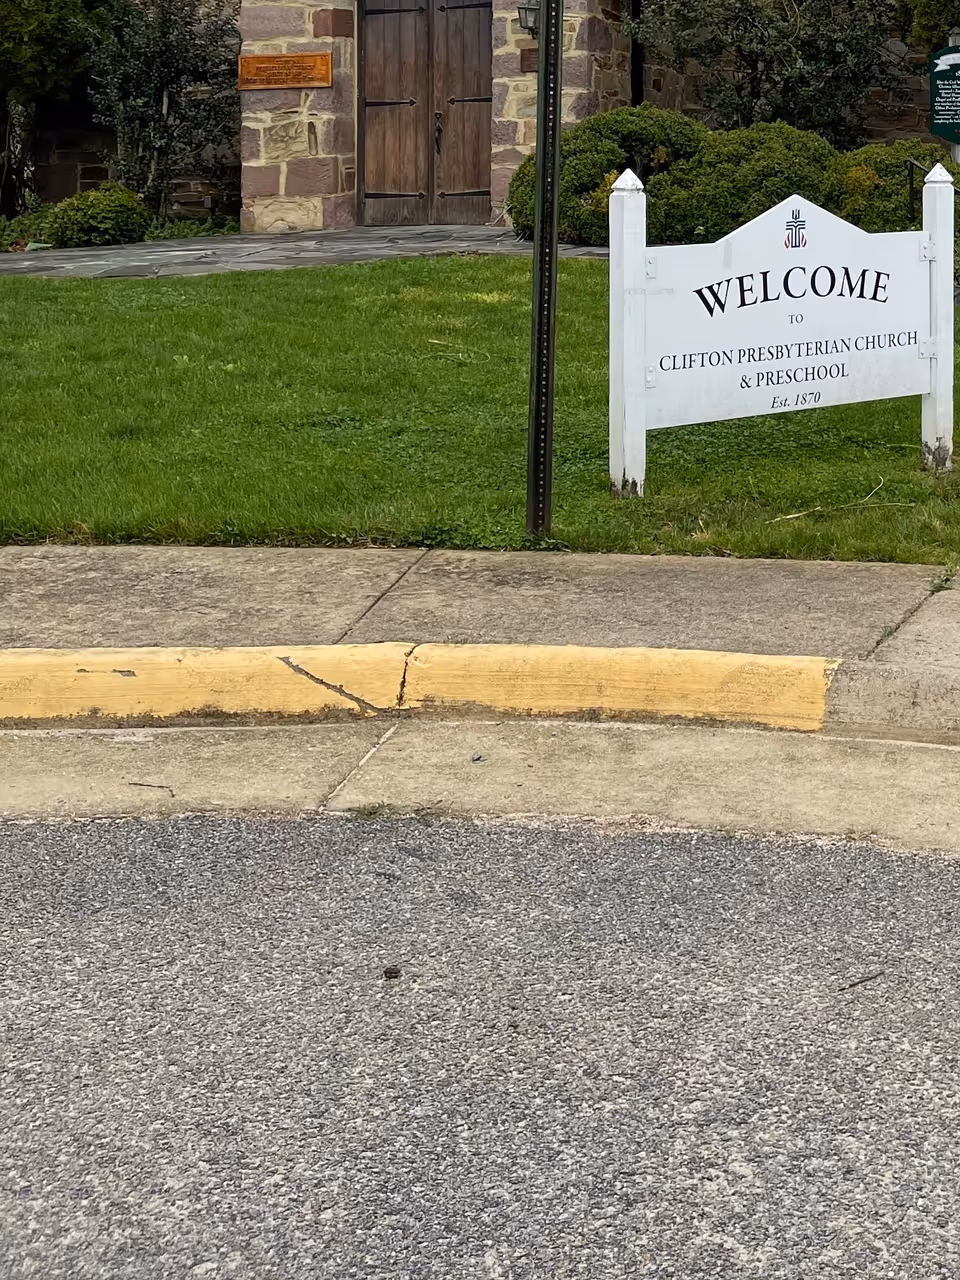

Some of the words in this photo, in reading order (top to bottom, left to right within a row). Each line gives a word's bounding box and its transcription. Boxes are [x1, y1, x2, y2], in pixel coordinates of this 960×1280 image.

[692, 265, 891, 318] WELCOME
[788, 313, 804, 325] TO
[659, 348, 734, 372] CLIFTON
[737, 337, 851, 363] PRESBYTERIAN
[854, 330, 918, 352] CHURCH
[740, 375, 753, 389] &
[756, 363, 849, 387] PRESCHOOL
[770, 395, 791, 410] Est.
[794, 391, 821, 407] 1870
